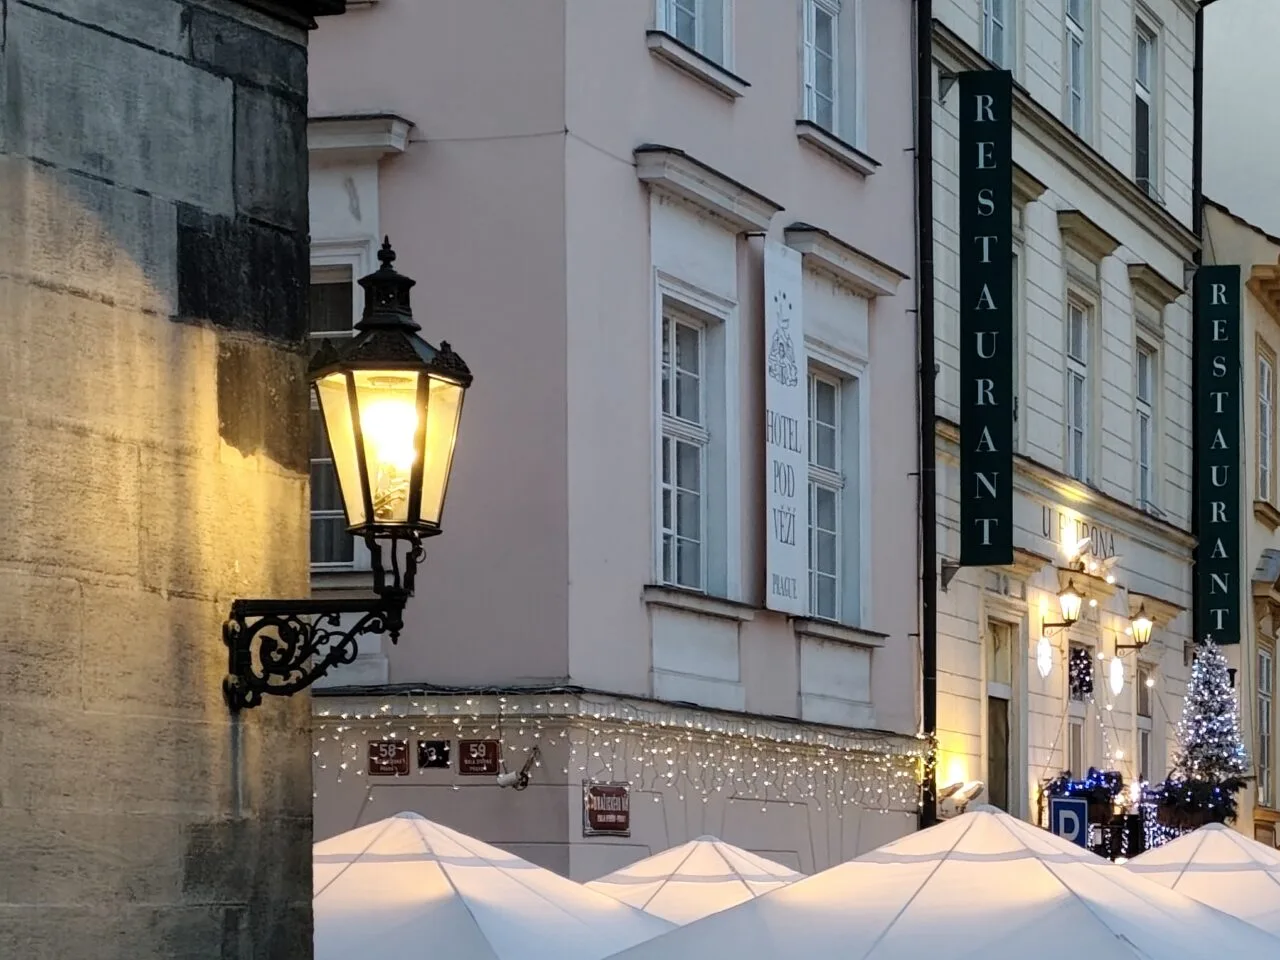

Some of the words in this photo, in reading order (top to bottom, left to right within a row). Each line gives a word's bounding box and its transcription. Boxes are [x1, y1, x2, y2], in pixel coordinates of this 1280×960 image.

[974, 94, 999, 547] RESTAURANT
[766, 409, 802, 453] HOTEL
[1209, 282, 1232, 631] RESTAURANT
[773, 459, 795, 498] POD
[772, 504, 797, 546] VĚŽÍ
[1042, 504, 1051, 540] U
[1058, 512, 1115, 559] PTRONA
[379, 743, 396, 757] 58
[469, 743, 487, 757] 59
